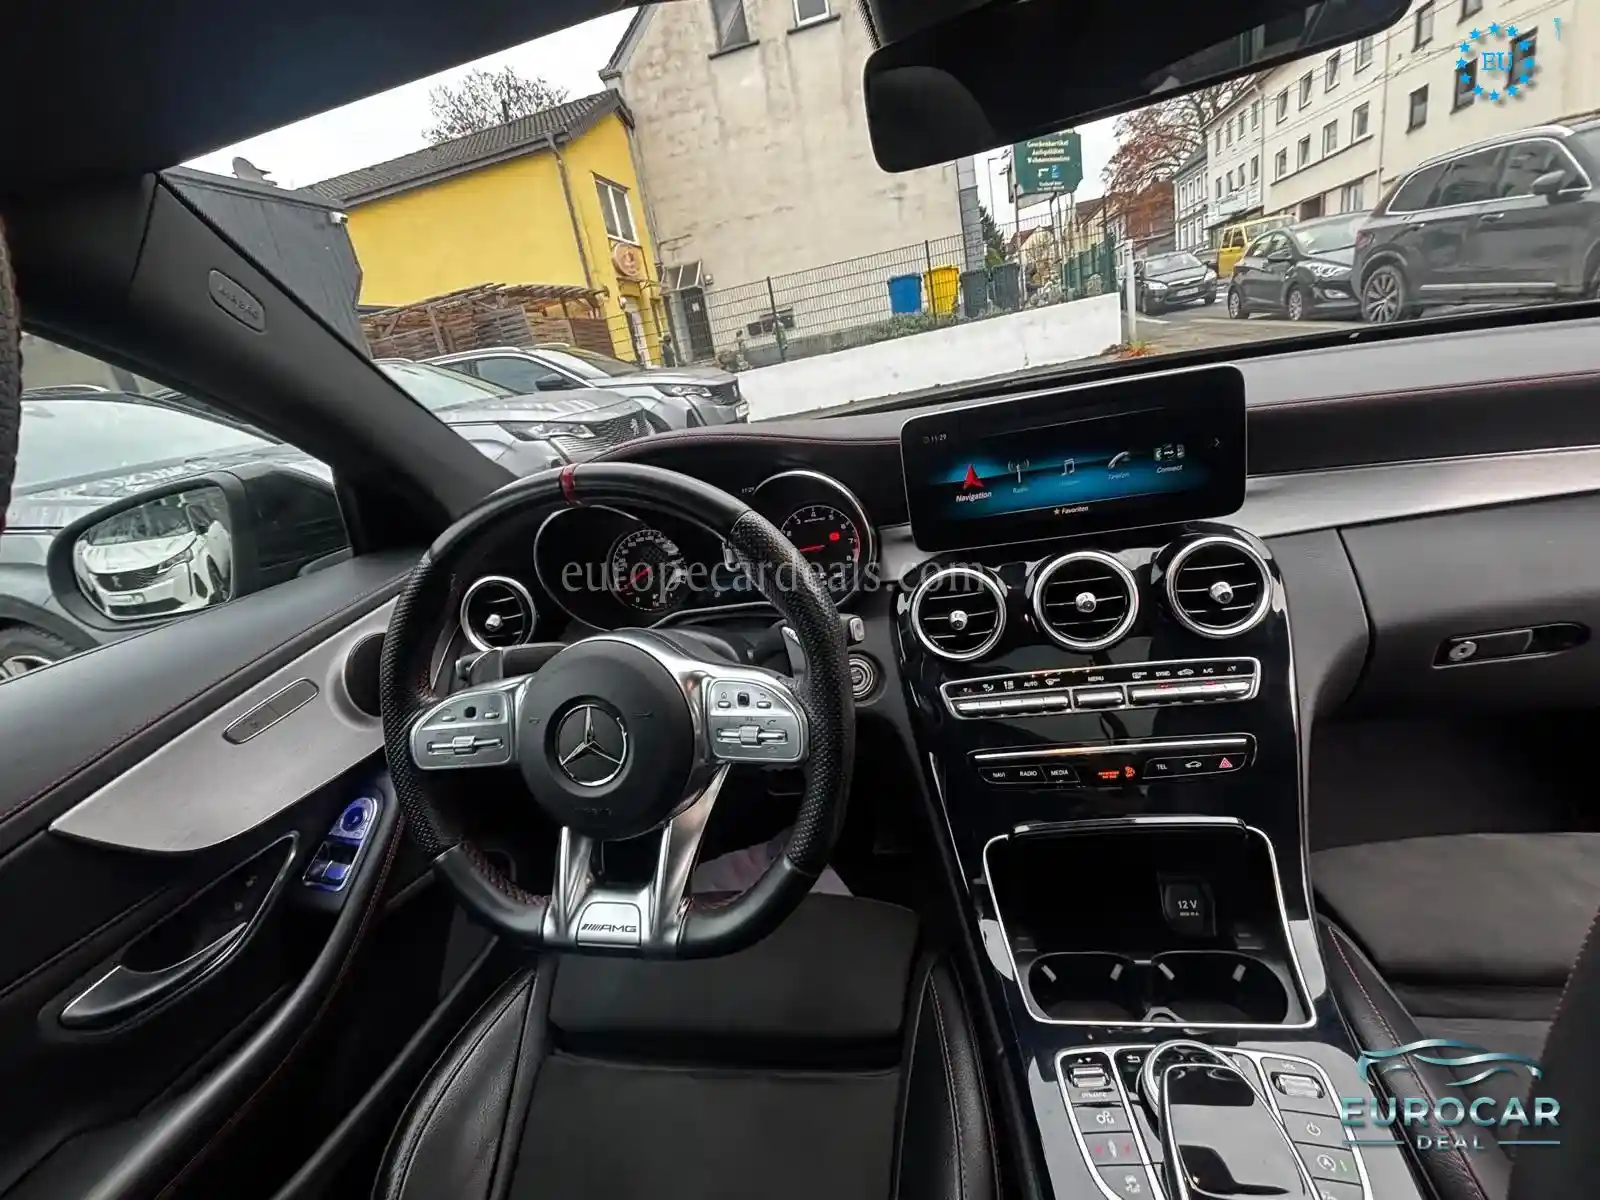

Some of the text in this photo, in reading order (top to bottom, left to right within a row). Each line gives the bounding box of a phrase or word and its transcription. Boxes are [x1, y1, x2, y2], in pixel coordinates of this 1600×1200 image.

[955, 491, 992, 502] Navigation
[1061, 505, 1089, 514] Favoriten
[1050, 769, 1068, 777] MEDIA
[1177, 899, 1197, 909] 12 V
